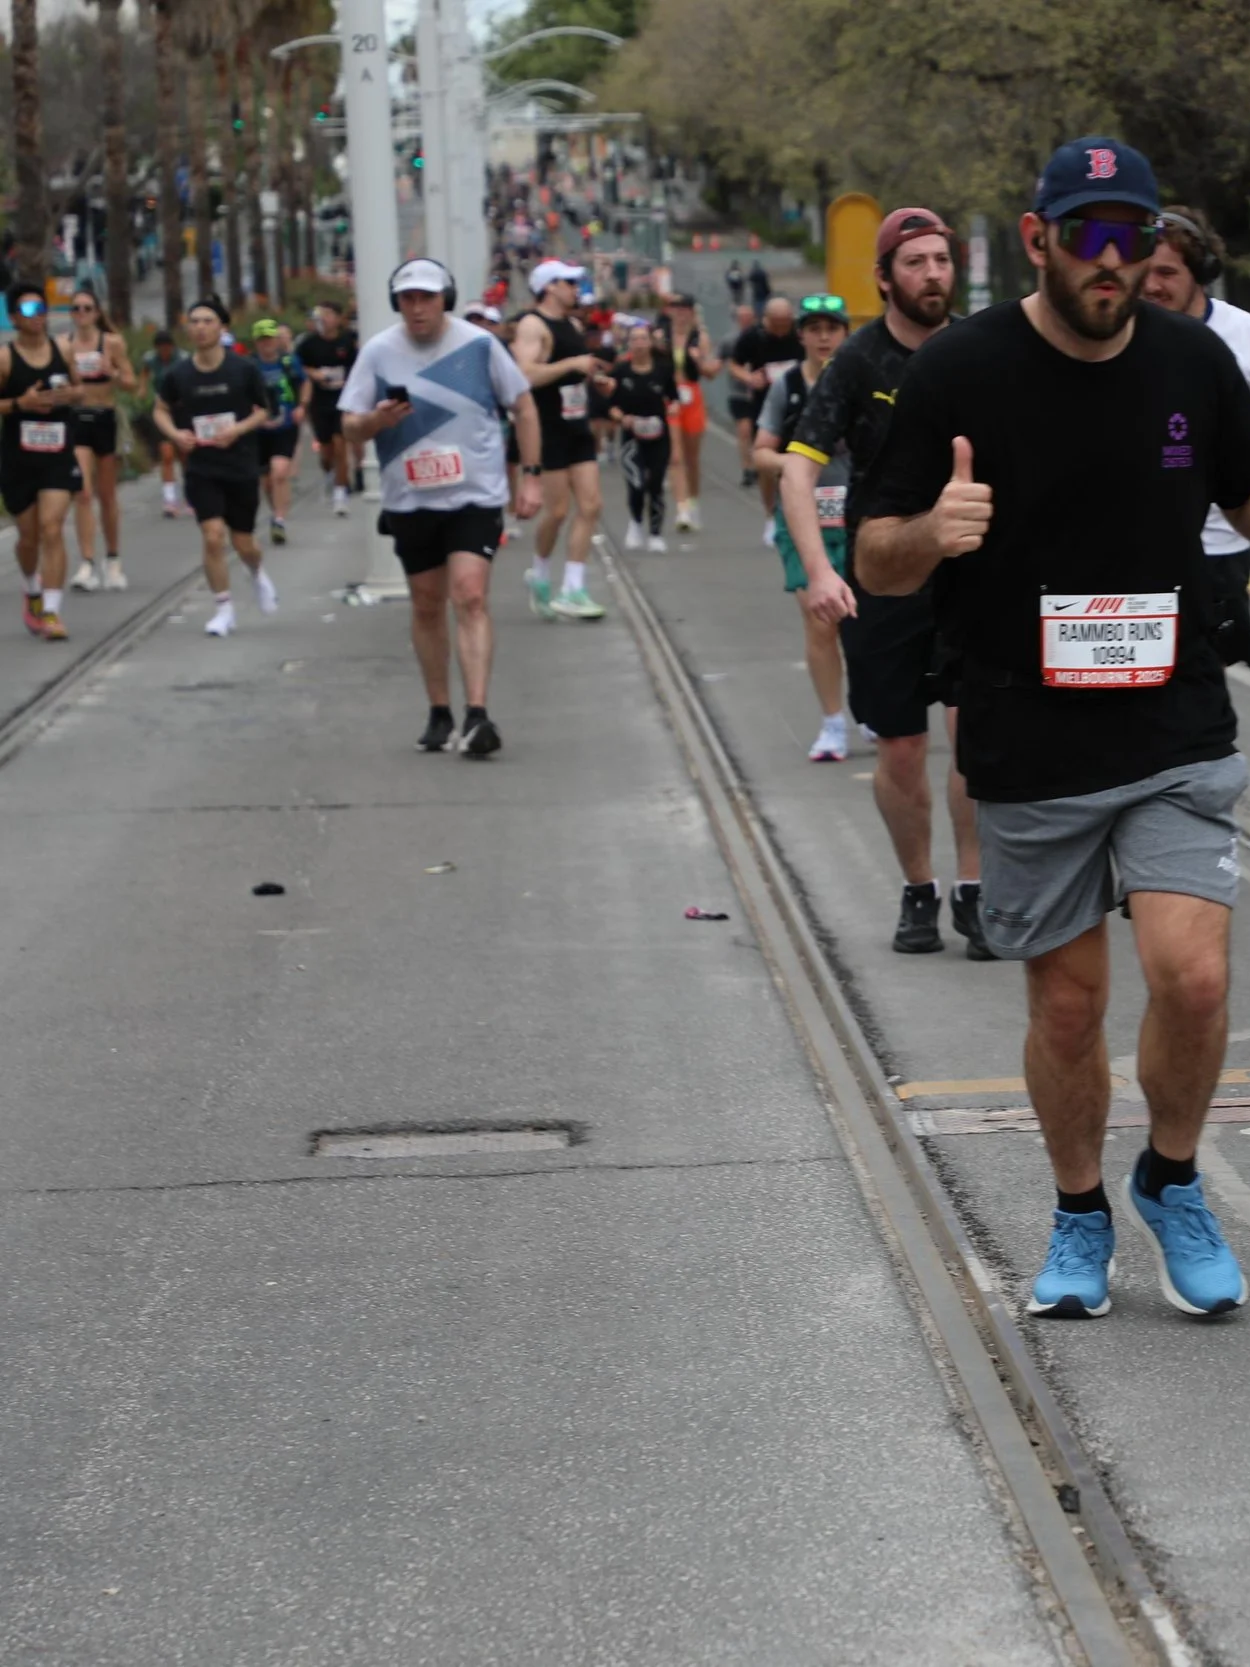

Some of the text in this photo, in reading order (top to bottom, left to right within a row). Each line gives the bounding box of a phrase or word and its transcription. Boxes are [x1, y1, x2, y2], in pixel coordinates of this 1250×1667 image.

[351, 33, 378, 54] 20
[360, 67, 375, 83] A
[1084, 148, 1118, 179] B
[1058, 621, 1163, 642] RAMMBO RUNS
[1091, 646, 1137, 665] 10994
[1054, 669, 1166, 684] MELBOURNE 2025
